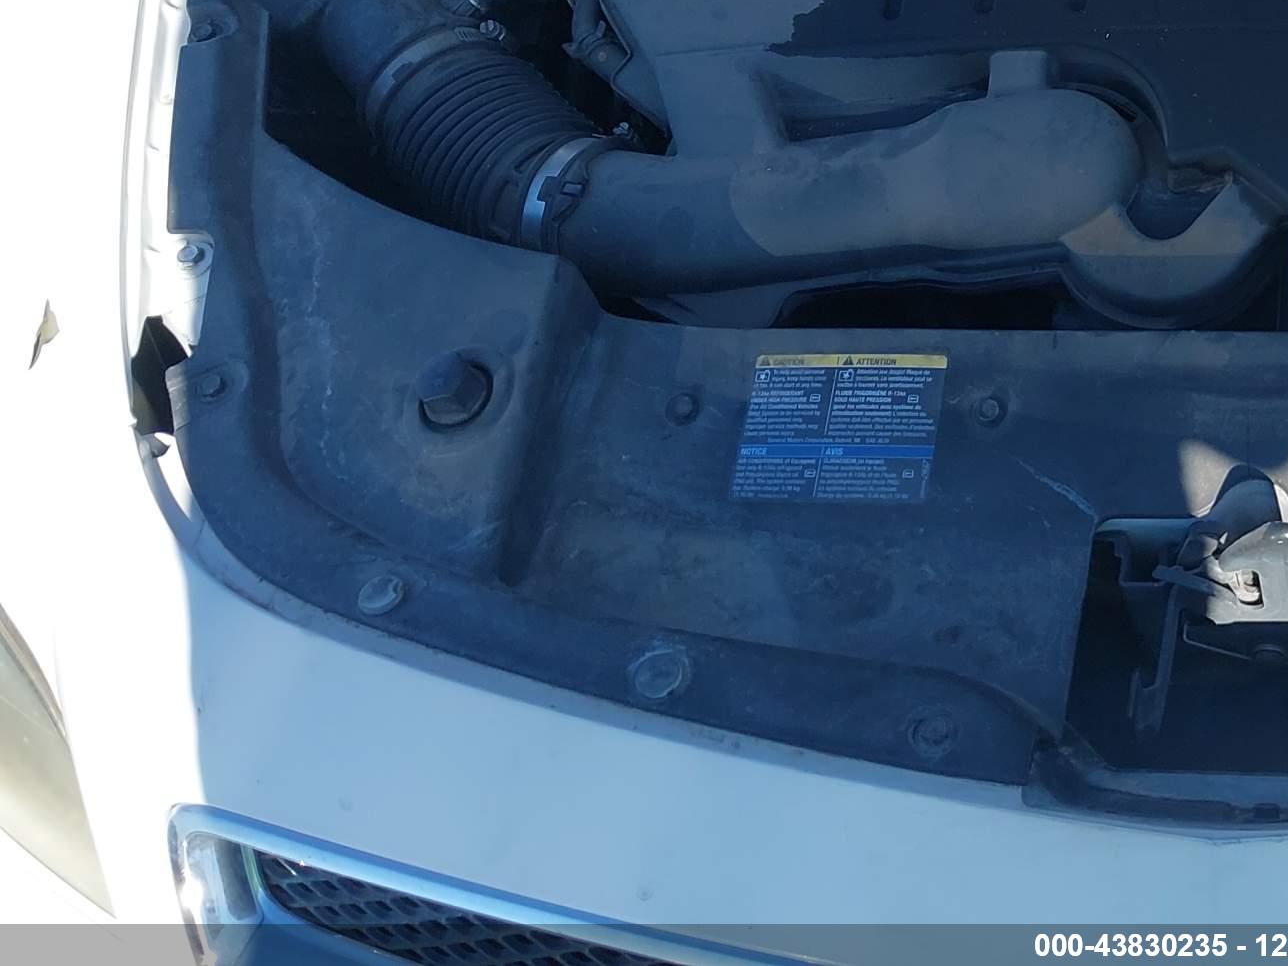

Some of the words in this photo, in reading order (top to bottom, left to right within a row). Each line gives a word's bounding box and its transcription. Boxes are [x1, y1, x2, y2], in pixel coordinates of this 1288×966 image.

[856, 358, 897, 366] ATTENTION
[740, 447, 768, 455] NOTICE
[825, 447, 844, 455] AVIS
